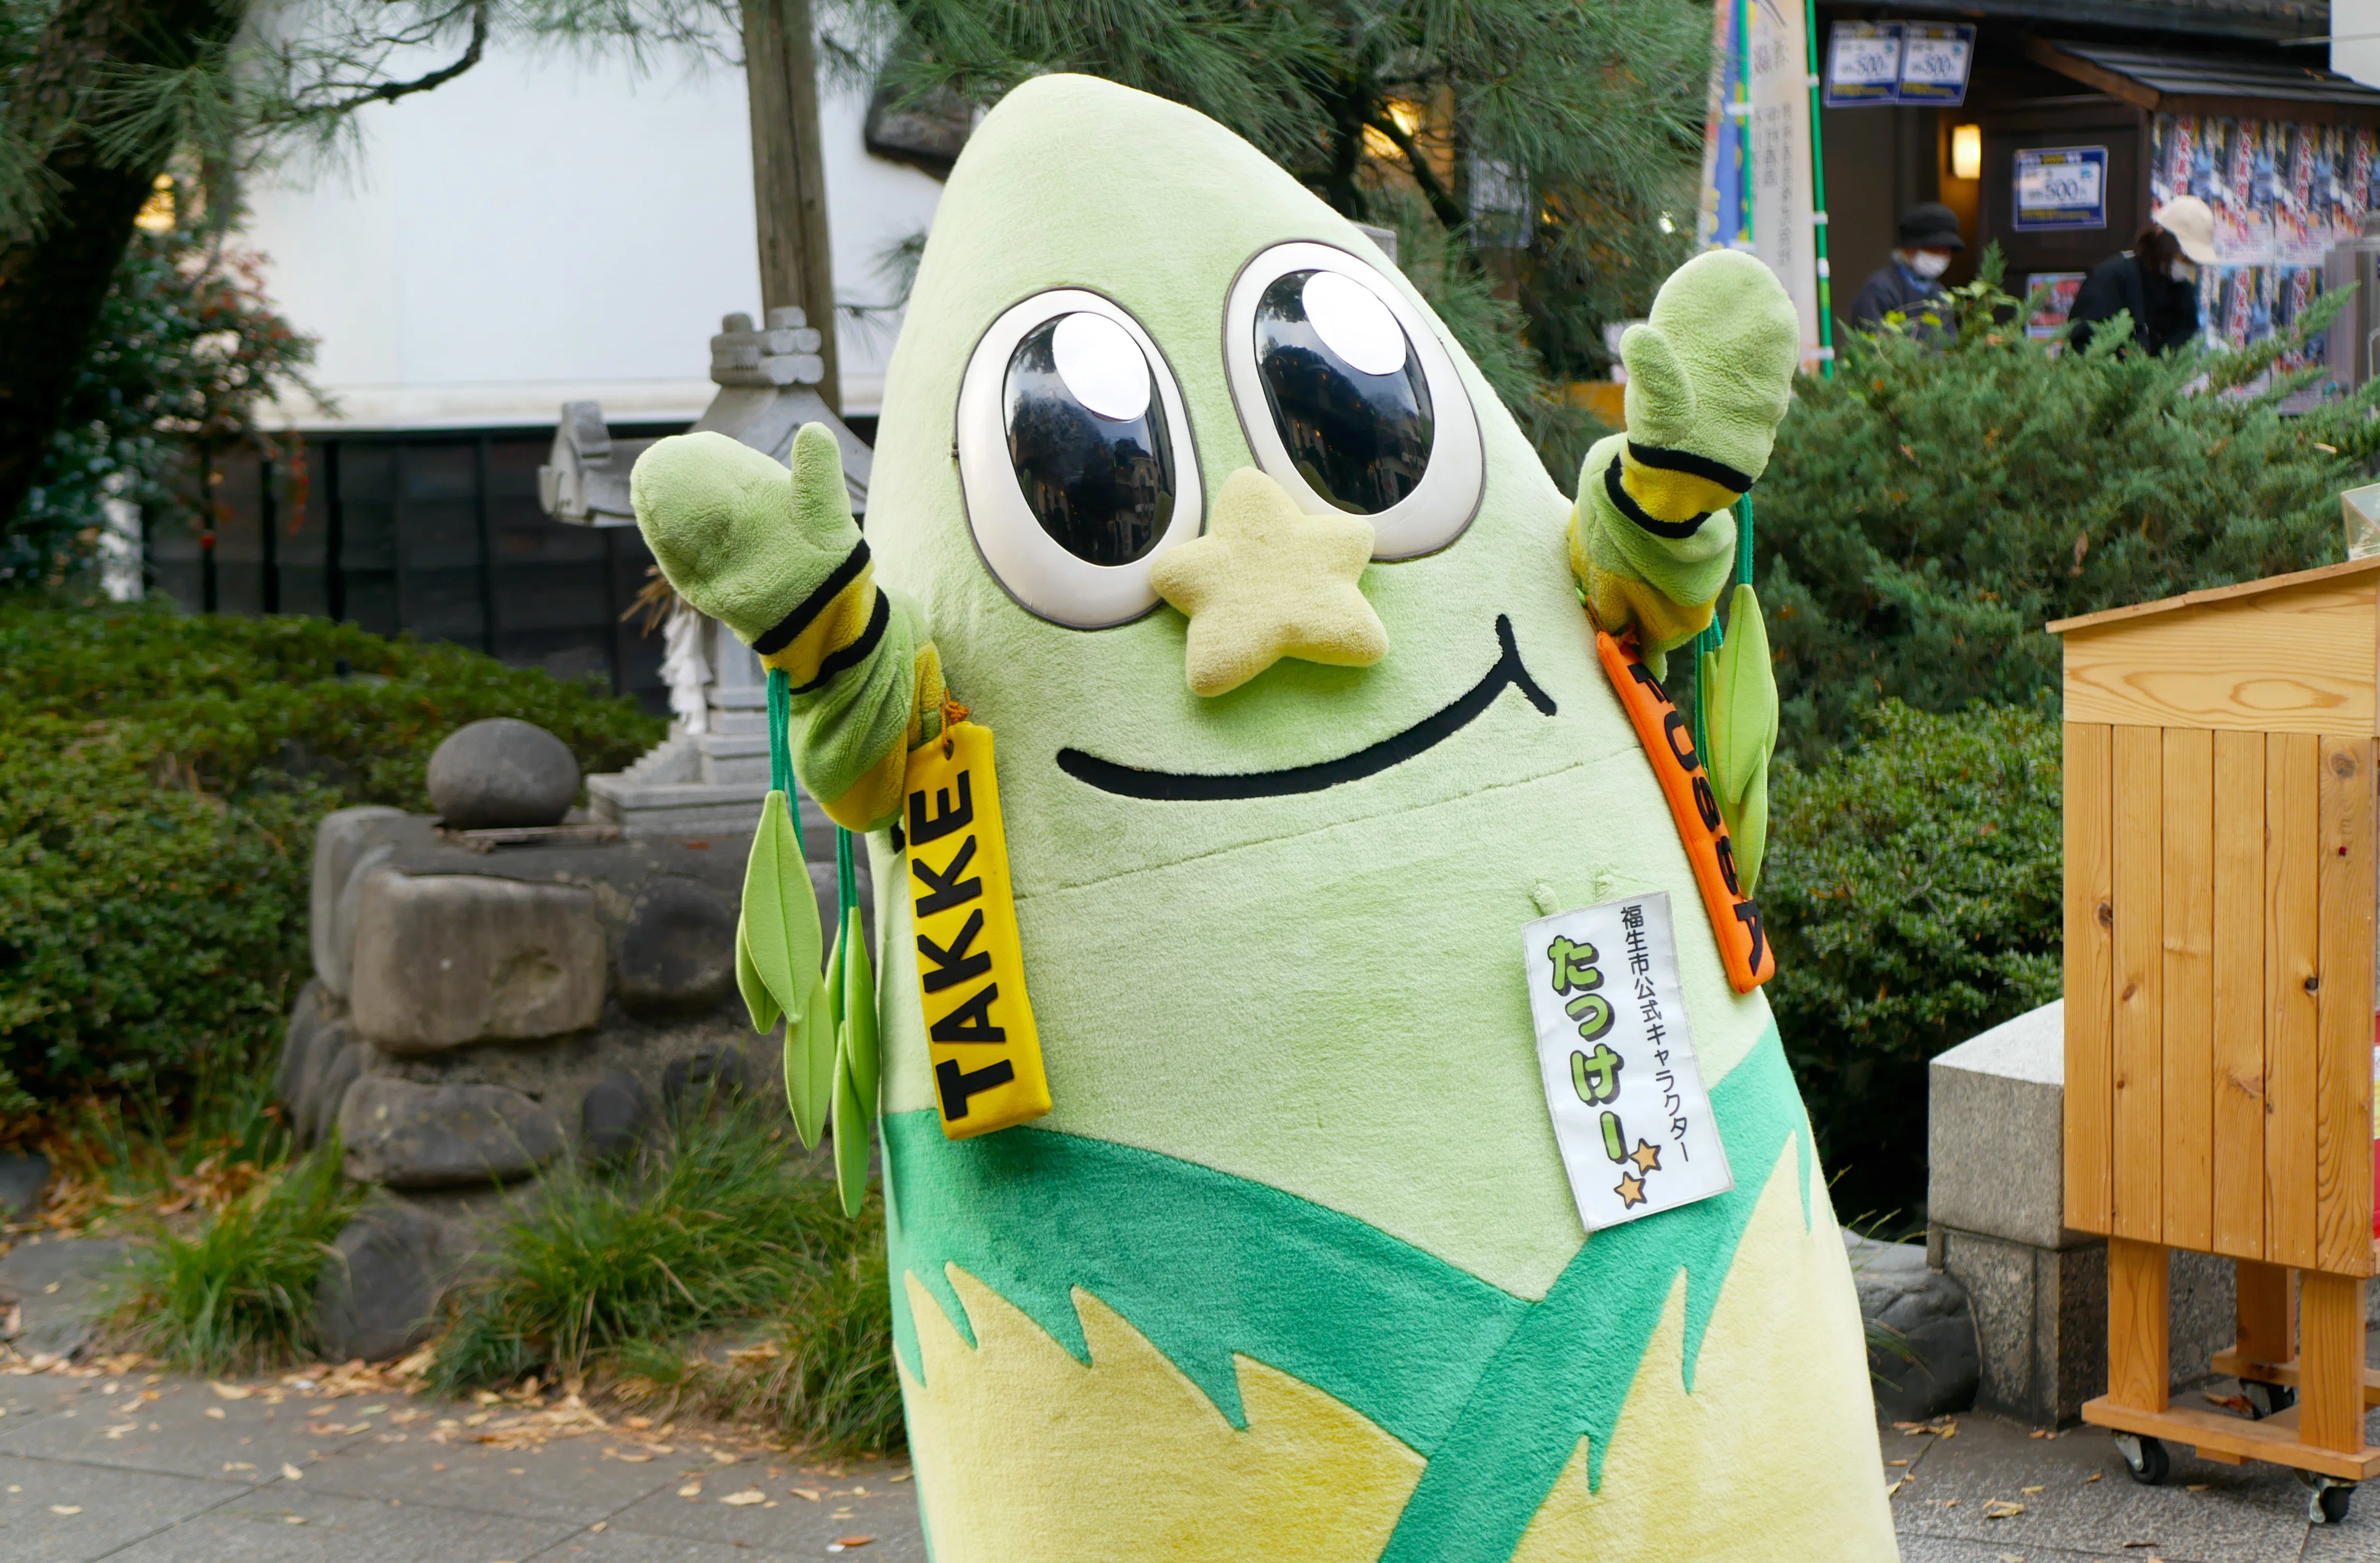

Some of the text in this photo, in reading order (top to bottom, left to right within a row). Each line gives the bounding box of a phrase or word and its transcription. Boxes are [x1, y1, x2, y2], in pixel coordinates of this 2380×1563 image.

[909, 770, 1015, 1121] TAKKE
[1627, 662, 1764, 977] FUSSA
[1621, 904, 1689, 1162] 福生市公式キャラクター
